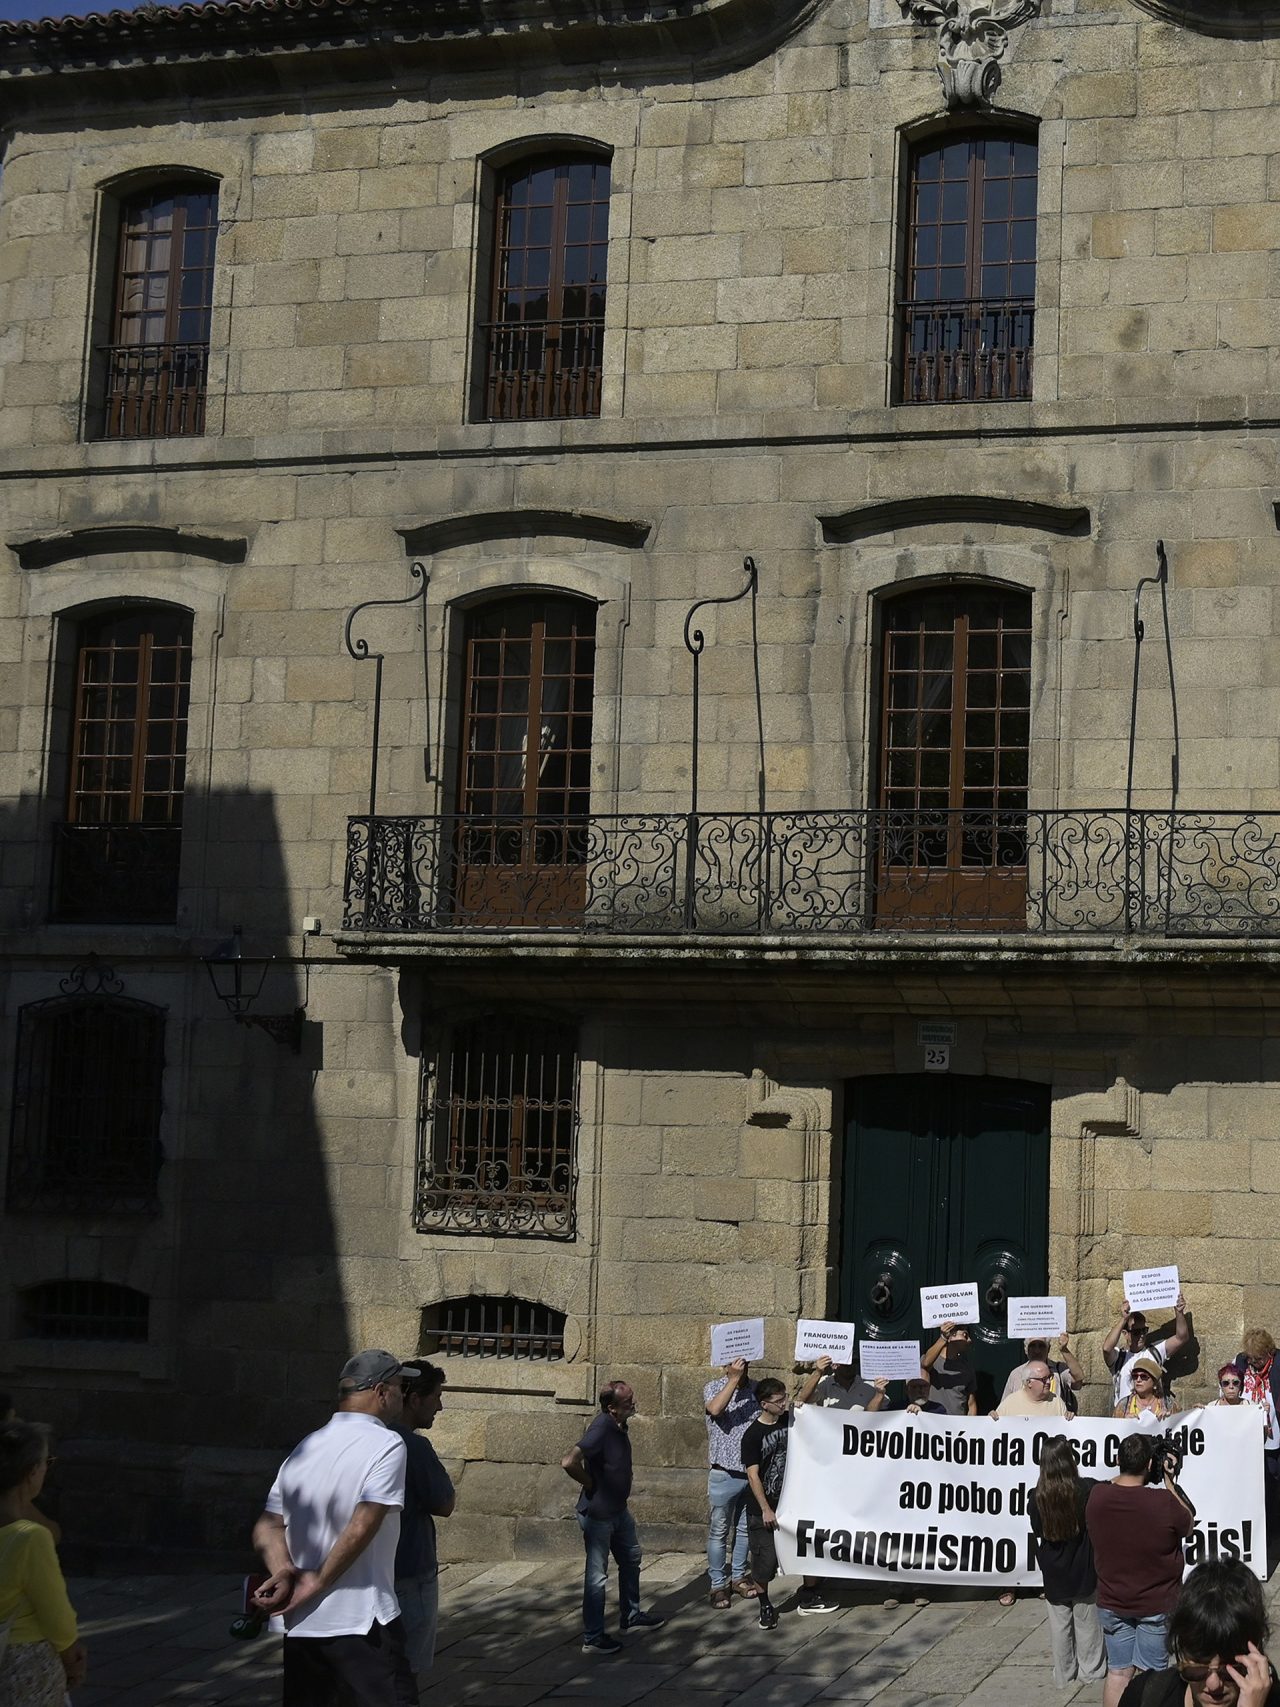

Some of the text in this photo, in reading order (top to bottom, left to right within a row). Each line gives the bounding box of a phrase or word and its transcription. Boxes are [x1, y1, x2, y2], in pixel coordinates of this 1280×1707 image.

[927, 1049, 946, 1065] 25
[940, 1291, 973, 1299] DEVOLVAN
[938, 1311, 969, 1319] ROUBADO
[803, 1332, 848, 1340] FRANQUISMO
[842, 1424, 985, 1465] Devolución
[992, 1432, 1025, 1466] da
[1032, 1431, 1096, 1467] Csa
[899, 1481, 932, 1509] ao
[938, 1481, 1003, 1515] pobo
[796, 1519, 1017, 1573] Franquismo
[1185, 1520, 1252, 1566] áis!
